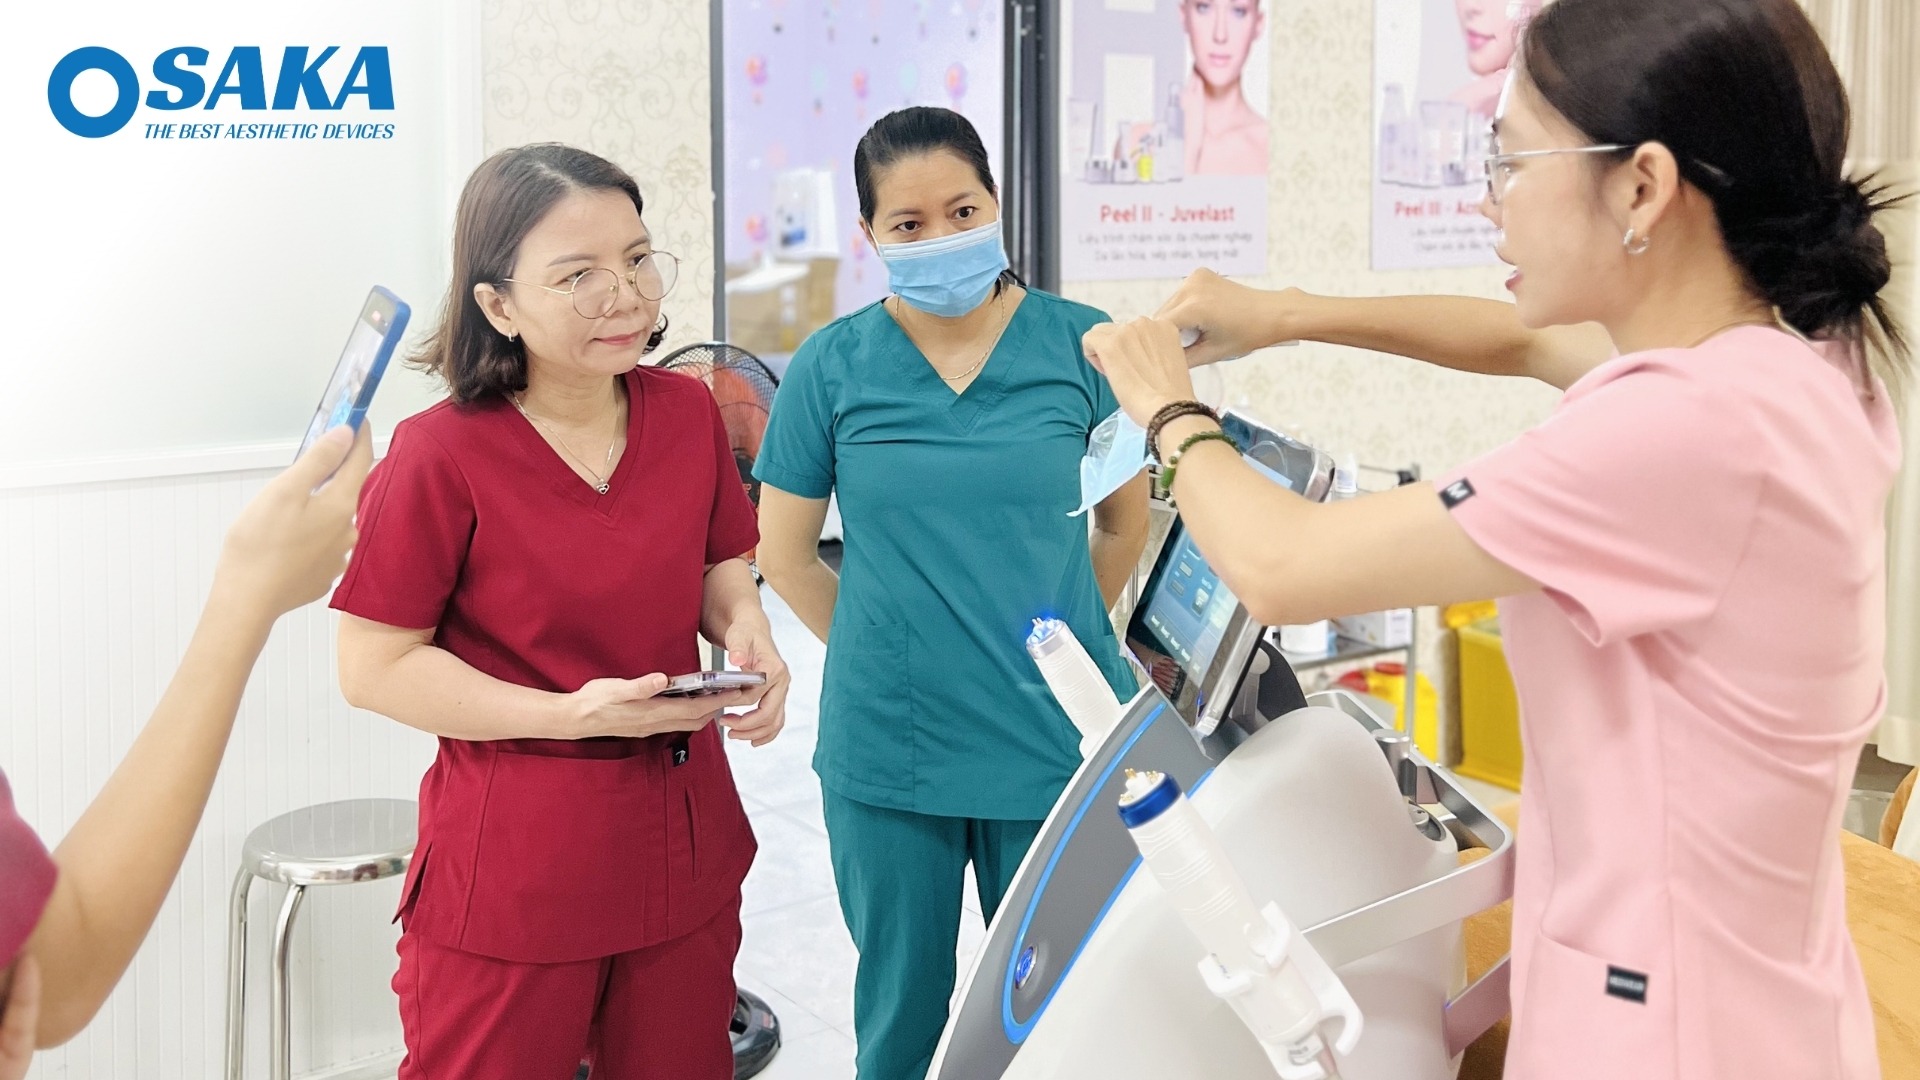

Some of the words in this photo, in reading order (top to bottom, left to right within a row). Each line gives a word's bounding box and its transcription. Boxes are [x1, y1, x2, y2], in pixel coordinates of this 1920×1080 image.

[1100, 205, 1137, 222] Peel
[1170, 204, 1236, 222] Juvelast
[1395, 201, 1423, 216] Peel
